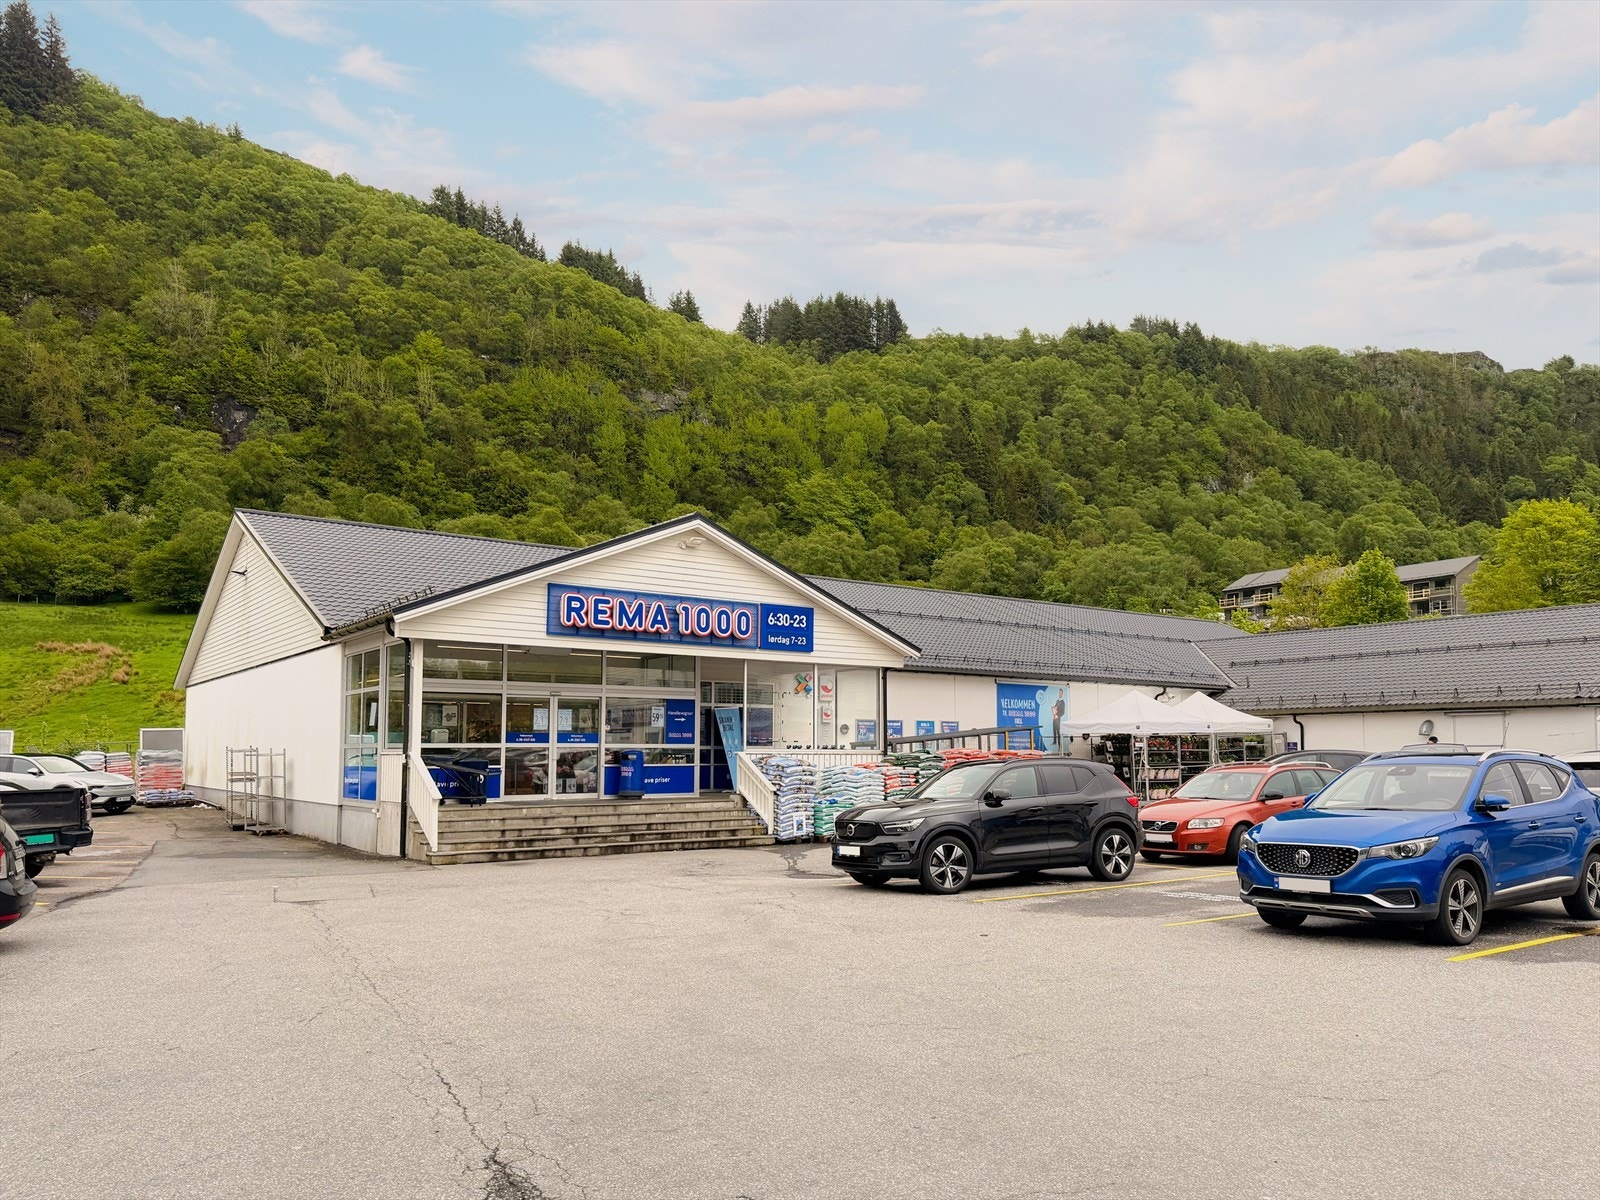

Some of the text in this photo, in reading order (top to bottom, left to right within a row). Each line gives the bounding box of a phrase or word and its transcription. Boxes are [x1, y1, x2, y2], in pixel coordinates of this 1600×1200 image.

[560, 592, 754, 640] REMA 1000
[767, 612, 807, 629] 6:30-23
[768, 634, 807, 646] lørdag 7-23
[1000, 698, 1036, 710] VELKOMMEN
[652, 712, 660, 722] 59
[654, 776, 671, 784] priser
[1295, 850, 1310, 866] MG
